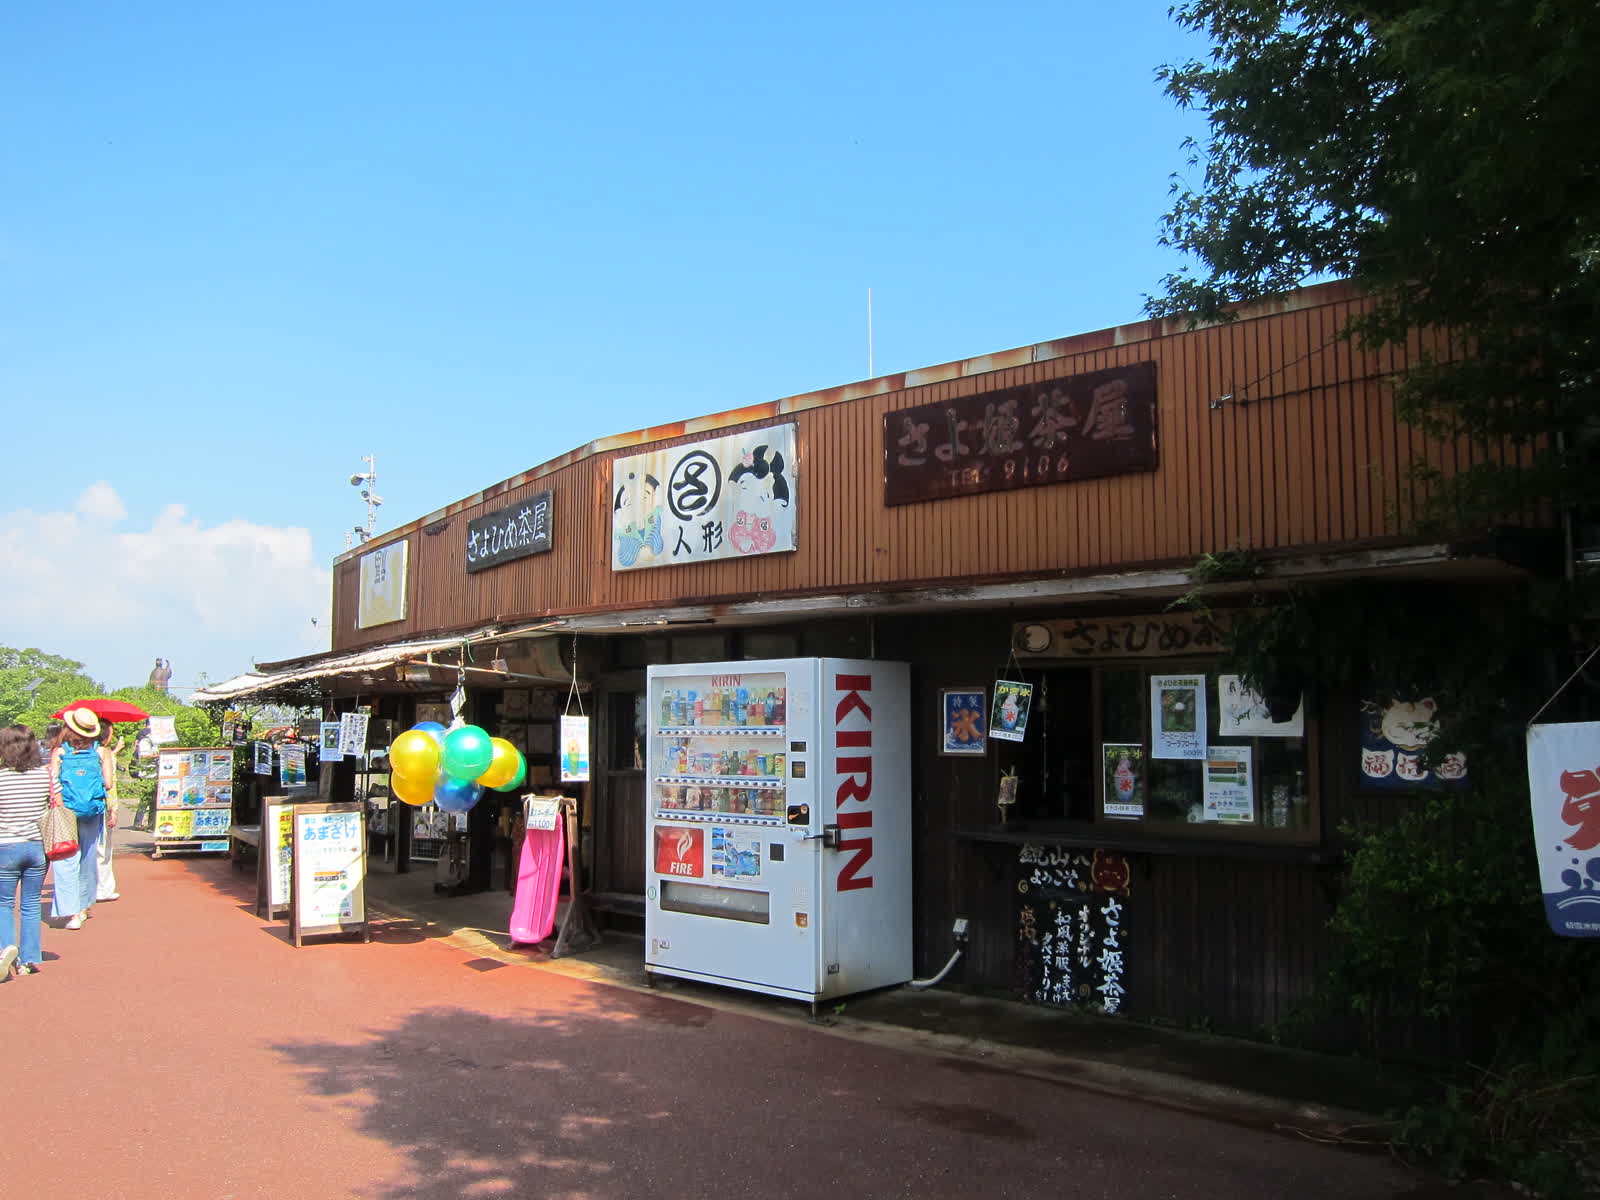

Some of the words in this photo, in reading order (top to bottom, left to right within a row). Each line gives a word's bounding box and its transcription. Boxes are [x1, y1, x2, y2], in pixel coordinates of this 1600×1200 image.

[467, 501, 547, 563] さよひめ茶屋
[673, 520, 723, 556] 人形
[712, 674, 741, 688] KIRIN
[997, 685, 1031, 697] かき氷
[951, 708, 982, 742] 氷
[835, 673, 874, 892] KIRIN
[196, 815, 230, 826] あまざけ
[303, 824, 358, 841] あまざけ
[670, 862, 694, 875] FIRE
[1030, 867, 1079, 889] ようこそ
[1077, 905, 1096, 968] オリジナル
[1041, 931, 1053, 1001] タペストリー
[1096, 897, 1126, 1015] さよ姫茶屋
